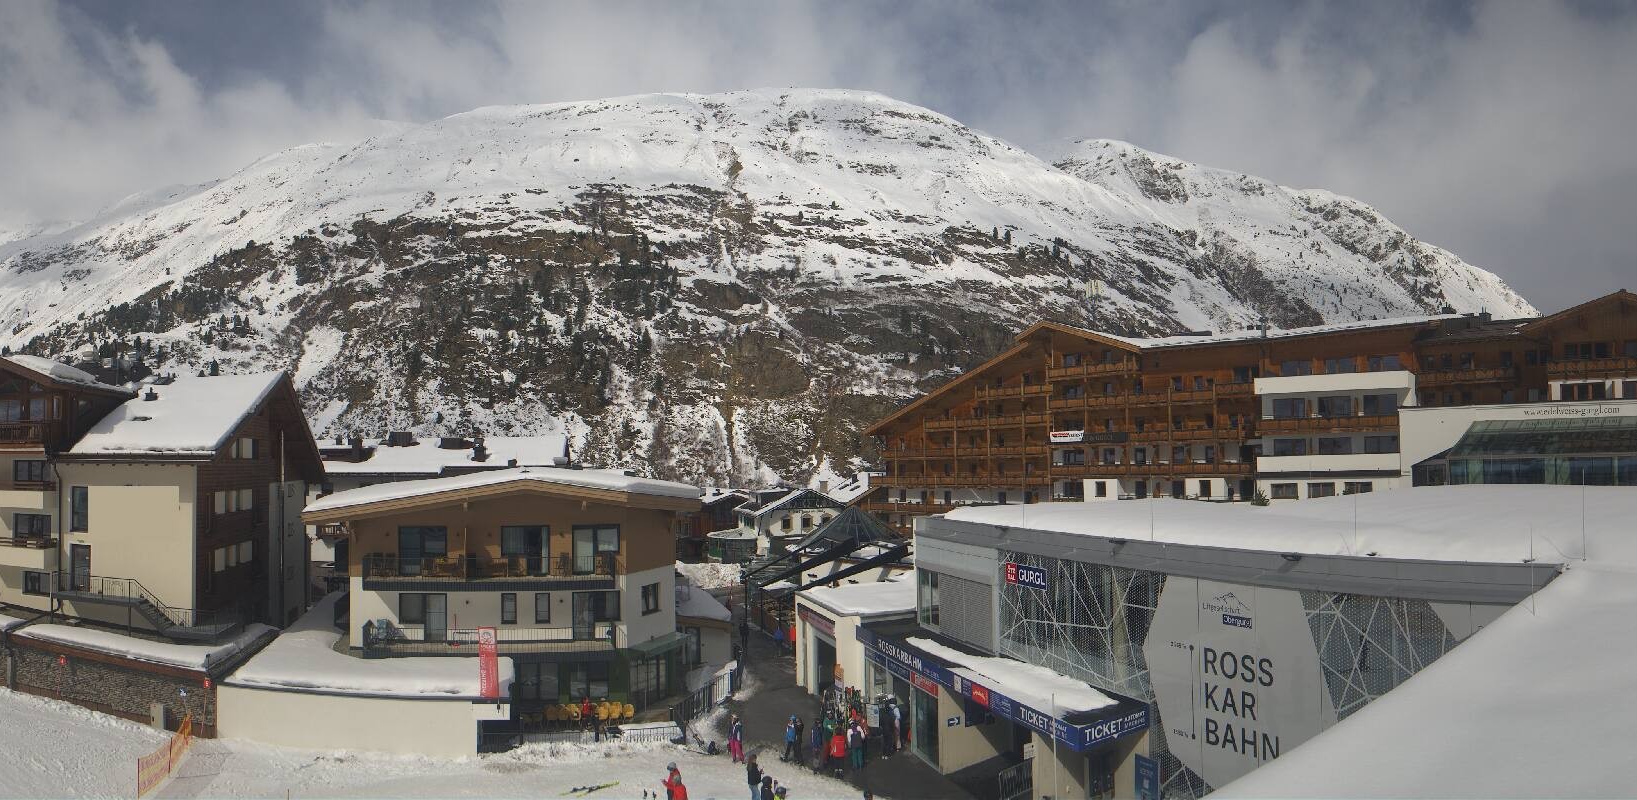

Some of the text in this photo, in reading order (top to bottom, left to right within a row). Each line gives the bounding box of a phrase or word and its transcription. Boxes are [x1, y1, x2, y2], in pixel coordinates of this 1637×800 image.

[1018, 569, 1046, 586] GURGL
[1204, 647, 1274, 687] ROSS
[1204, 682, 1257, 721] KAR
[1019, 706, 1049, 730] TICKET
[1084, 718, 1123, 742] TICKET
[1205, 718, 1280, 761] BAHN
